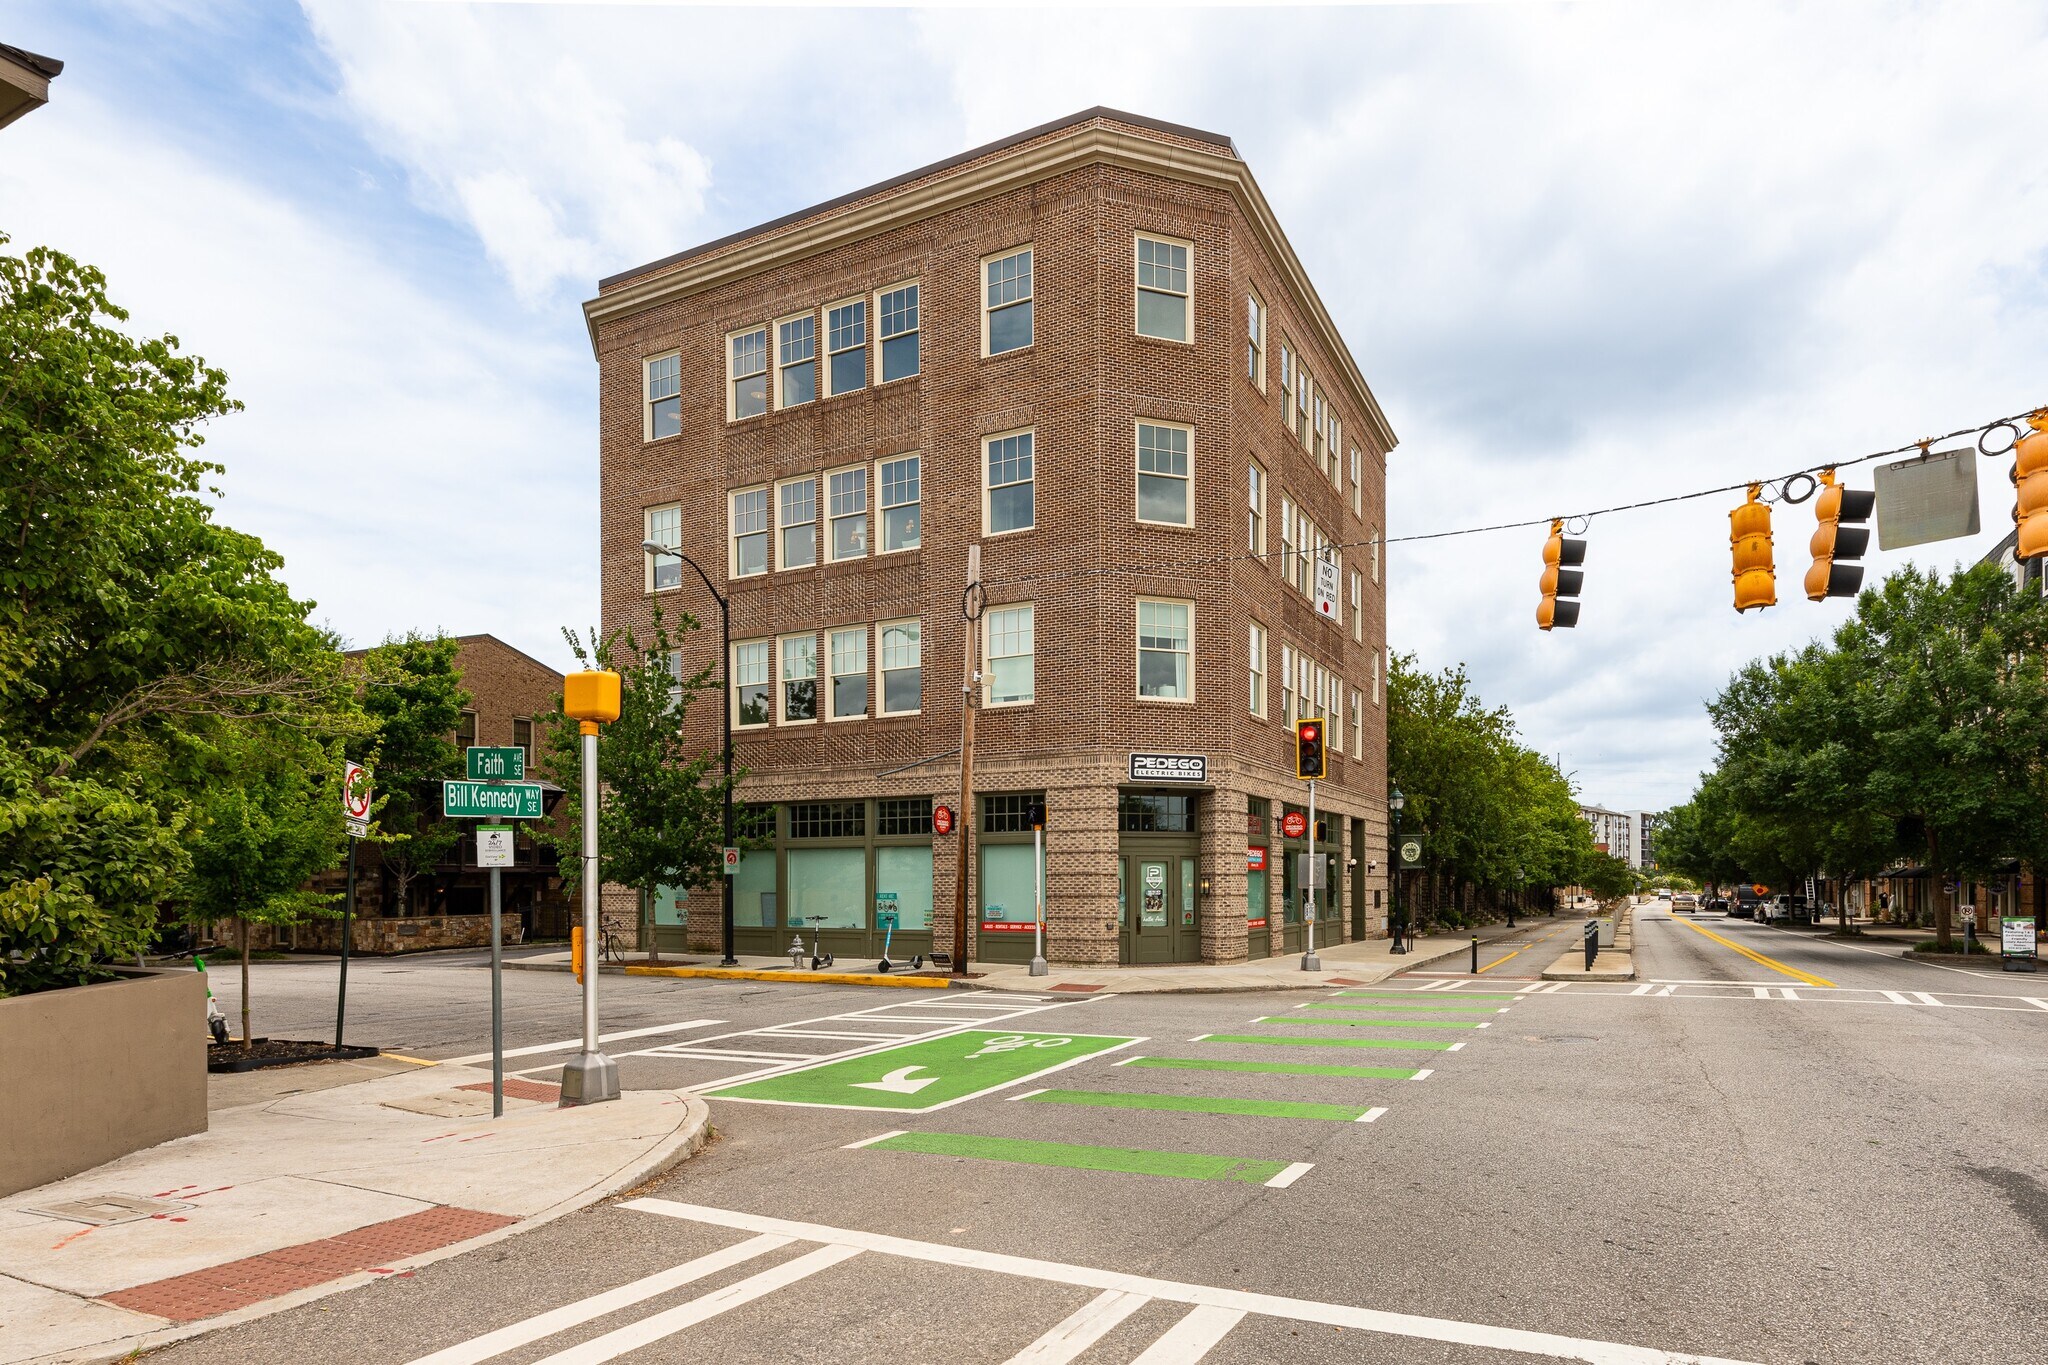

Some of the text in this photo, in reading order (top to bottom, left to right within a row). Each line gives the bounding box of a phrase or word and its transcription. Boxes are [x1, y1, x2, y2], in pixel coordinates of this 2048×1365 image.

[1322, 565, 1333, 579] NO
[1320, 577, 1334, 591] TURN
[1317, 587, 1335, 603] ON RED
[477, 753, 504, 775] Faith
[513, 753, 522, 762] AVE
[1134, 757, 1203, 770] PEDEGO
[513, 765, 521, 776] SE
[448, 784, 521, 815] Bill Kennedy
[525, 789, 539, 800] WAY
[527, 801, 537, 812] SE
